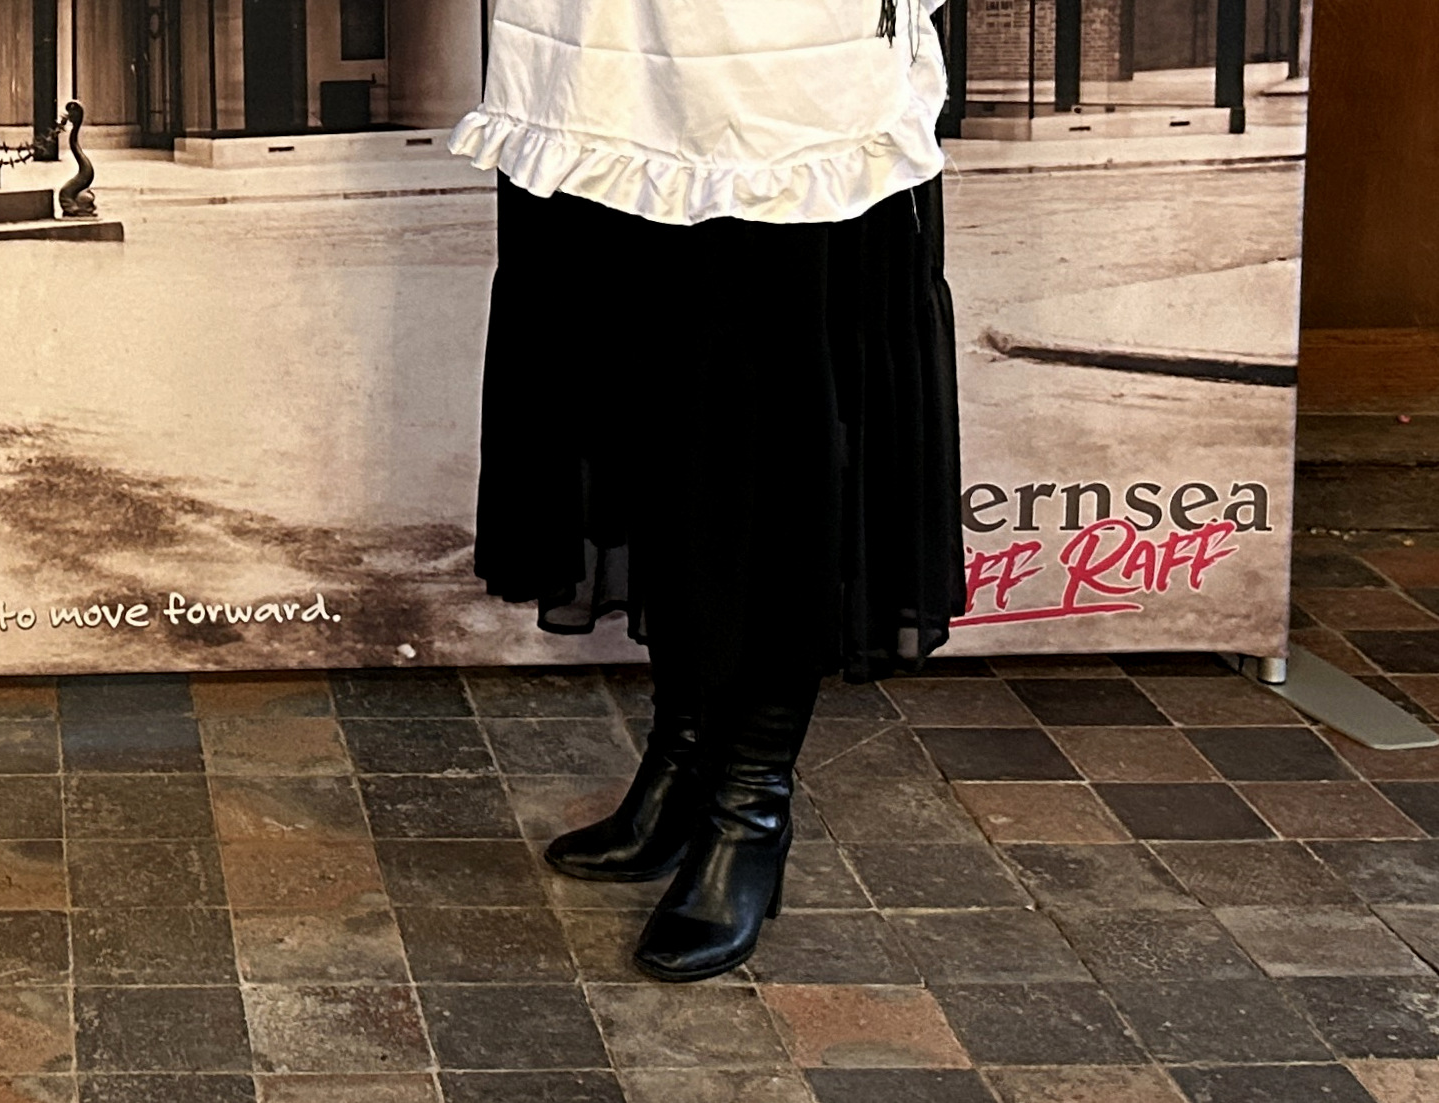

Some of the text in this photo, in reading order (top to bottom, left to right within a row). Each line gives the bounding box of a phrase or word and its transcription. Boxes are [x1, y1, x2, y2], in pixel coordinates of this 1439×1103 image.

[964, 541, 1043, 613] FF
[51, 602, 151, 629] move
[163, 592, 343, 626] forward.
